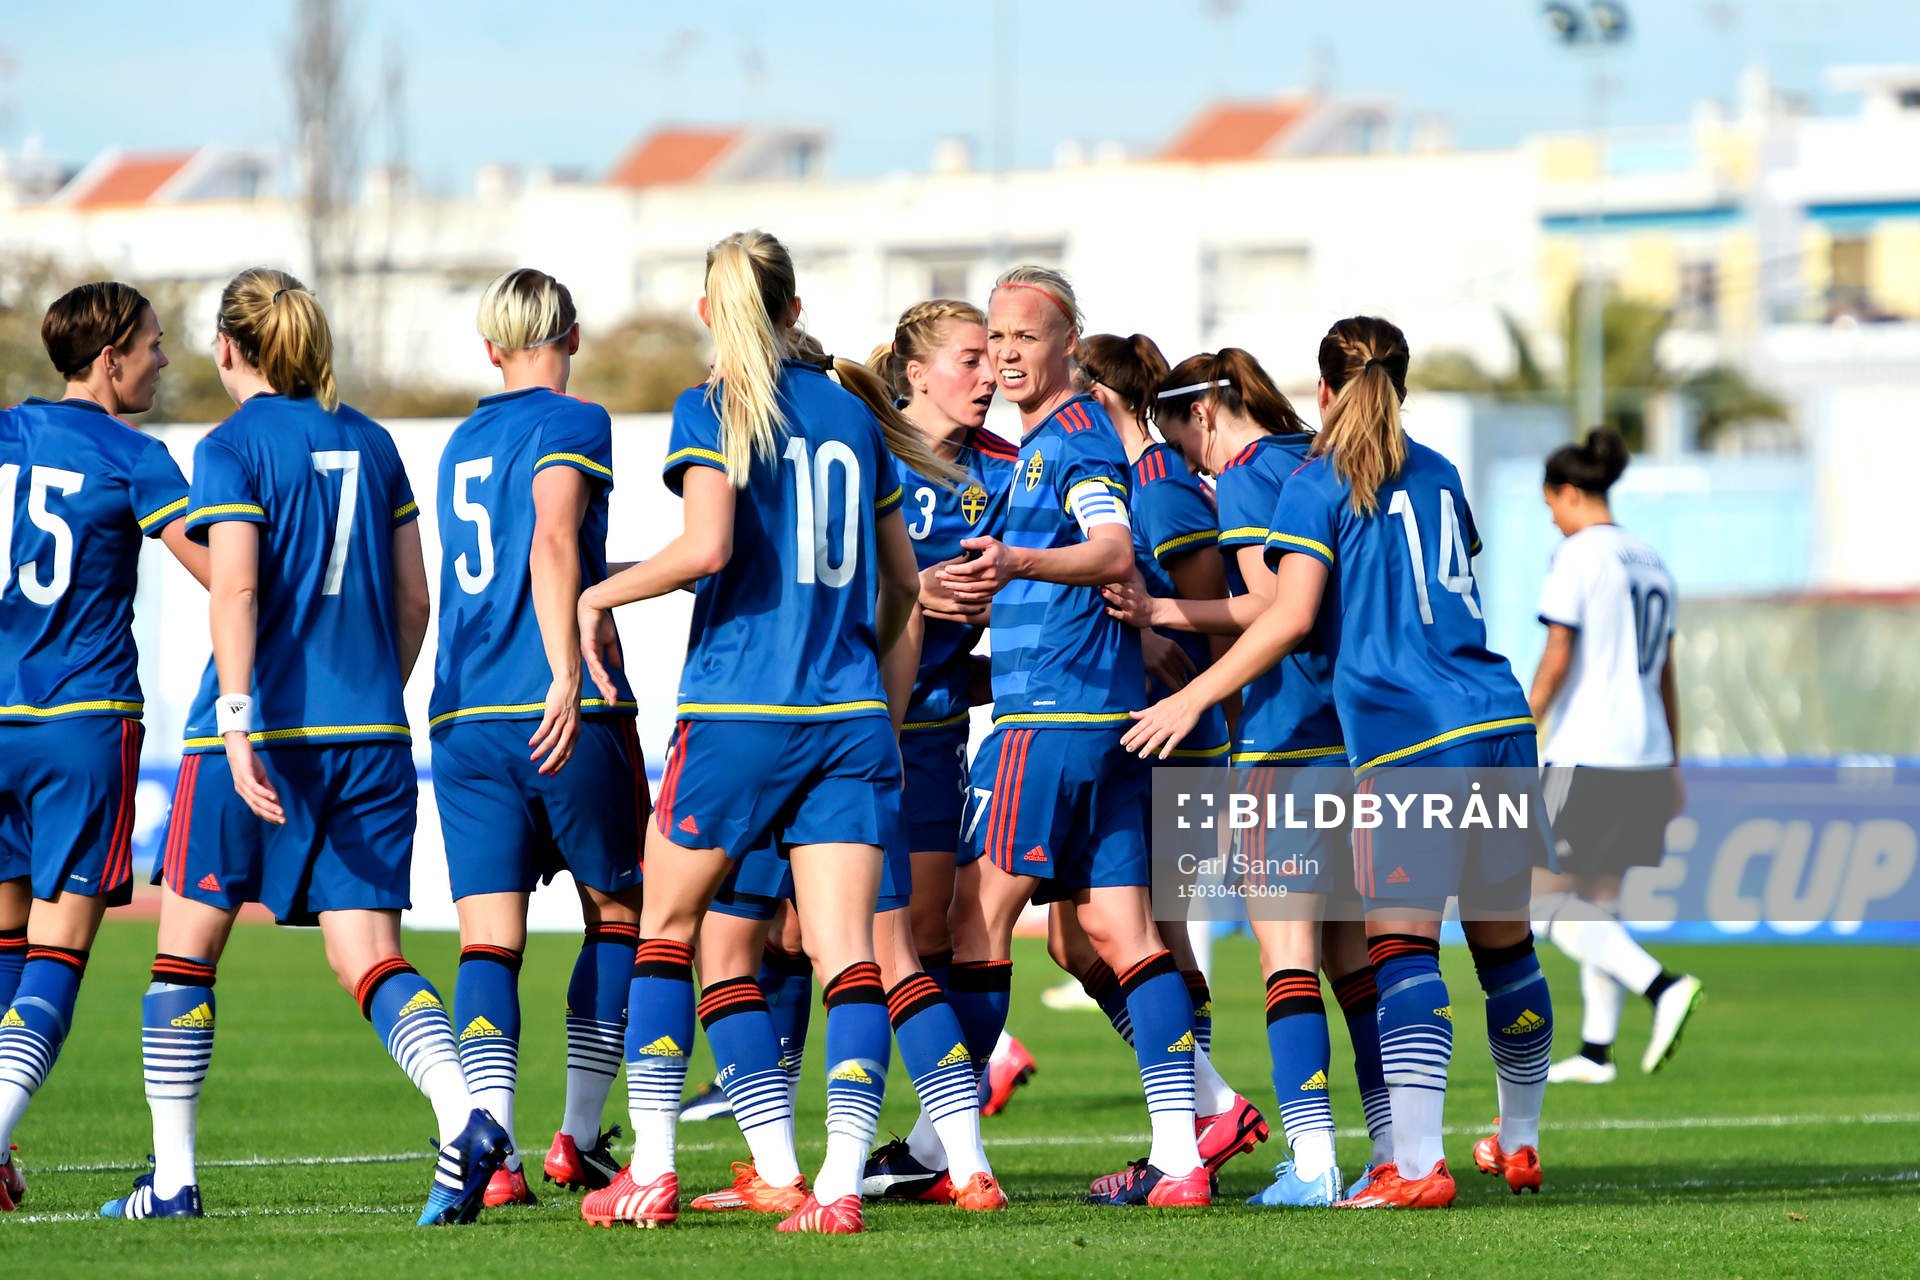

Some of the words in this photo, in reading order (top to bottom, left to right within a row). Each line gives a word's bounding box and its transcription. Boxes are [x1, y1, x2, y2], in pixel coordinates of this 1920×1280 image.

[0, 463, 85, 606] 15
[310, 450, 360, 596] 7
[452, 456, 494, 595] 5
[783, 436, 860, 588] 10
[908, 486, 937, 540] 3
[1388, 488, 1482, 625] 14
[1629, 581, 1668, 676] 10
[1703, 817, 1917, 936] CUP
[170, 1018, 214, 1028] adida
[398, 1000, 443, 1017] adida
[459, 1028, 502, 1041] adidas
[639, 1047, 684, 1057] adidas
[1502, 1017, 1545, 1035] adidas
